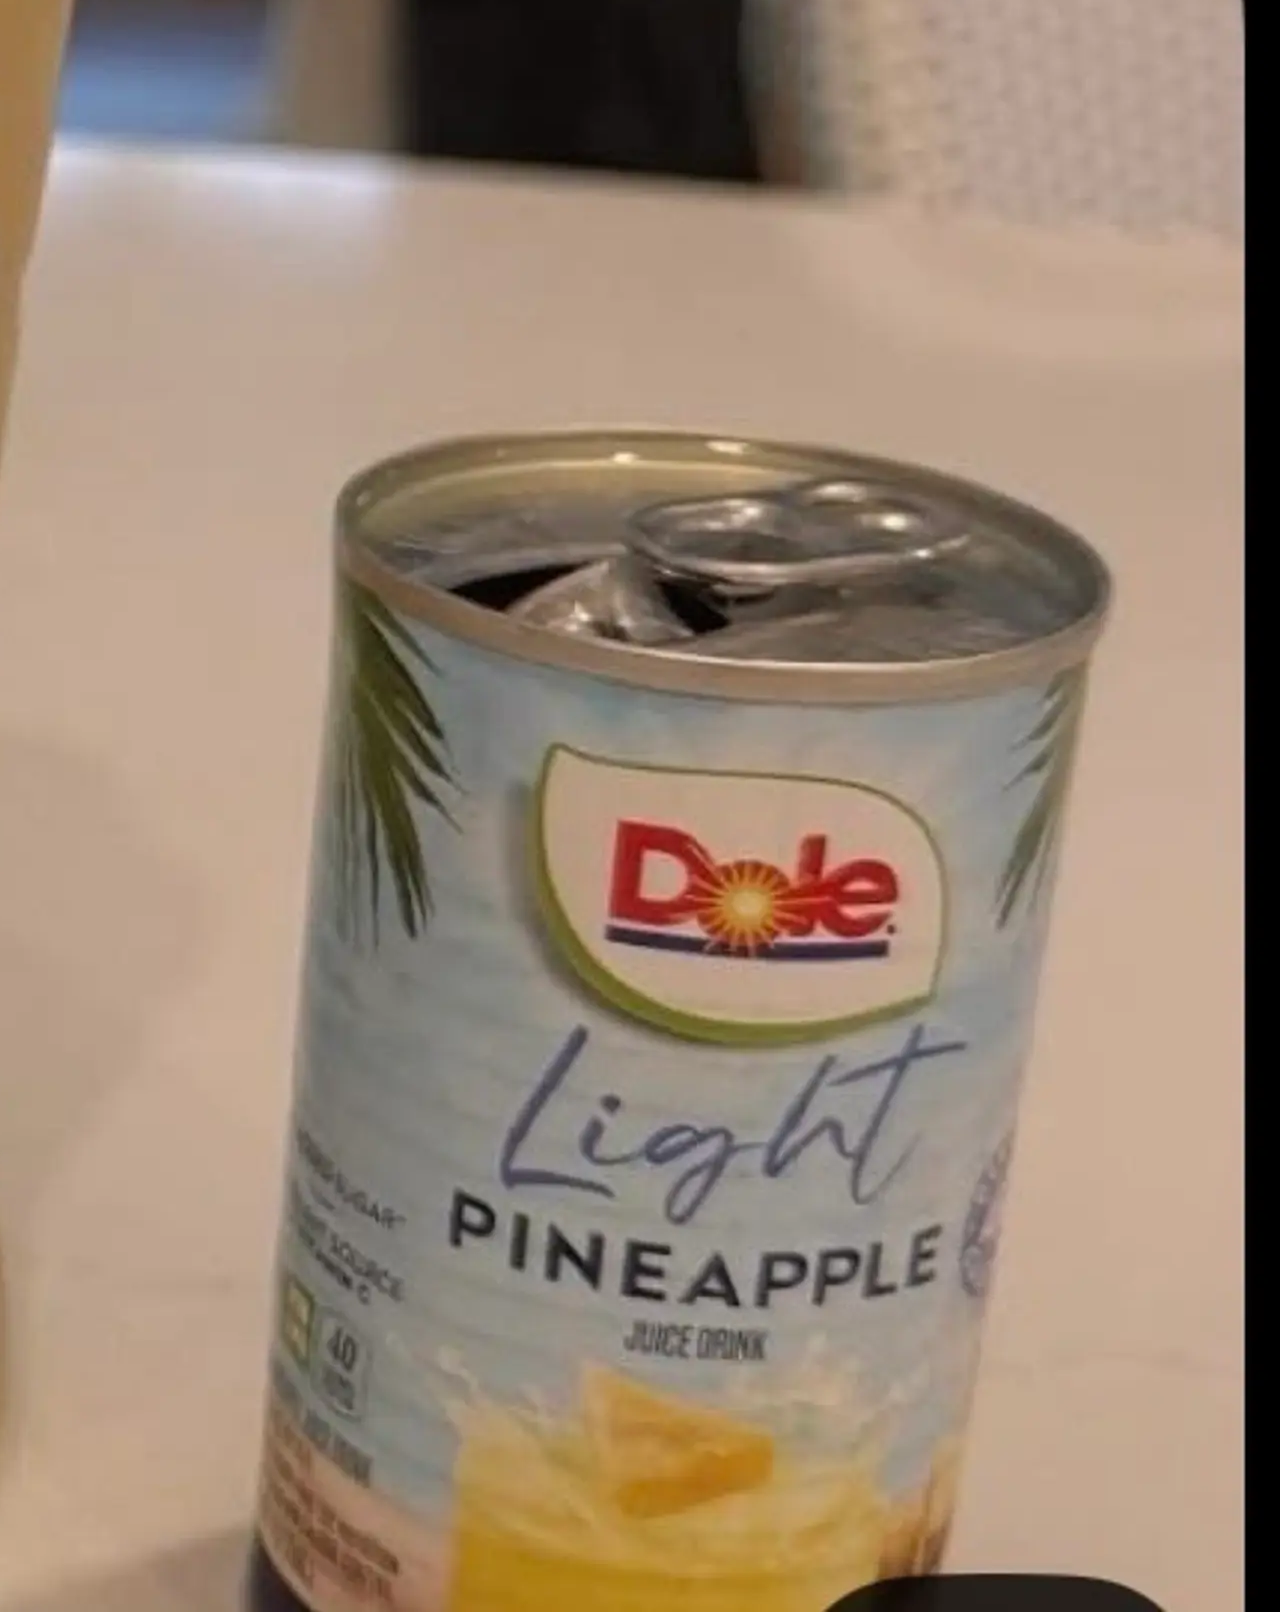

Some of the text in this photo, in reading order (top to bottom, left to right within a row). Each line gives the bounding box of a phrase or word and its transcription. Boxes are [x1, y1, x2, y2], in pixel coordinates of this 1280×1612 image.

[608, 820, 900, 939] Dole
[498, 1023, 966, 1224] Light
[449, 1189, 943, 1307] PINEAPPLE
[624, 1318, 767, 1362] JUICE DRINK
